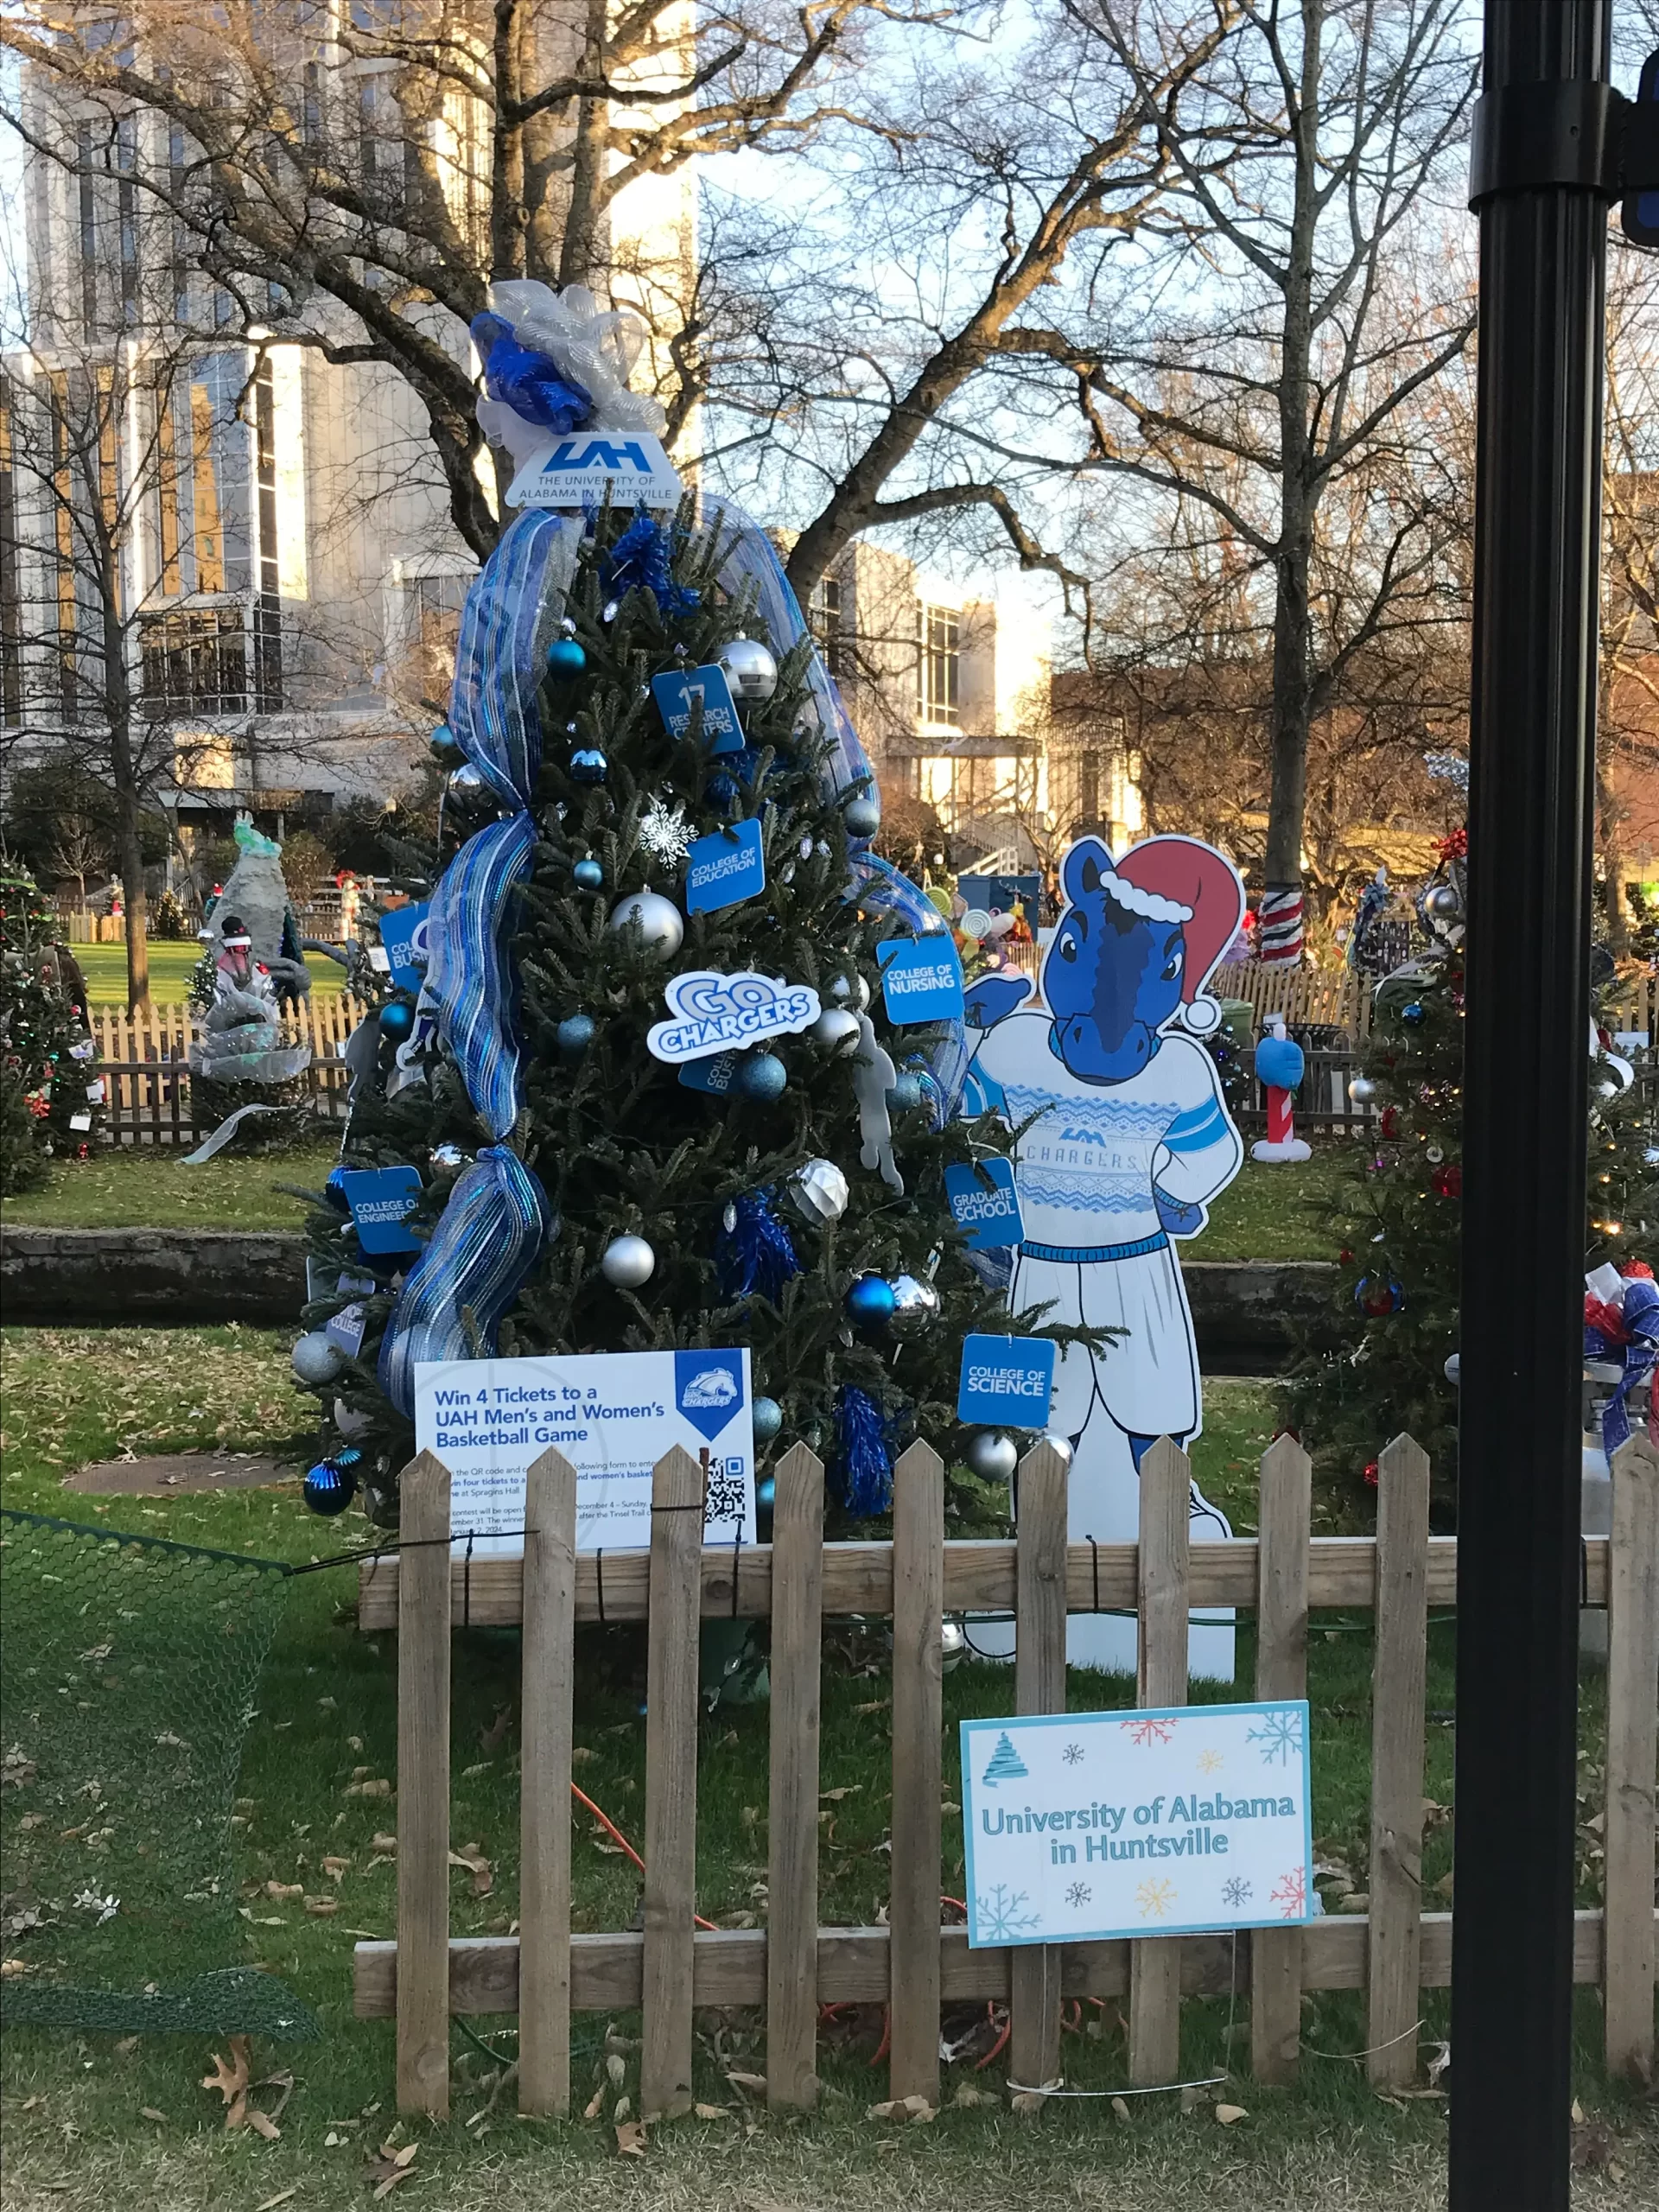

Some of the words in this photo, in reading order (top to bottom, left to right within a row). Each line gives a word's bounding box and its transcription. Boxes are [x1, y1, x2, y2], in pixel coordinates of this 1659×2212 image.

[542, 441, 652, 474] UAH
[538, 476, 561, 486] THE
[639, 476, 656, 486] OF
[520, 489, 577, 499] ALABAMA
[678, 684, 705, 710] 17
[668, 707, 730, 728] RESRCH
[692, 854, 738, 878] COLLEGE
[741, 847, 755, 860] OF
[692, 856, 755, 888] EDUCATION
[887, 966, 935, 981] COLLEGE
[937, 964, 952, 975] OF
[888, 975, 955, 995] NURSING
[677, 979, 776, 1023] GO
[658, 993, 810, 1054] CHARGERS
[1027, 1146, 1136, 1169] CHARGERS
[355, 1200, 404, 1213] COLLEGE
[406, 1199, 419, 1210] O
[953, 1187, 1013, 1207] GRADUATE
[957, 1199, 1016, 1223] SCHOOL
[331, 1315, 361, 1338] COLLEGE
[969, 1366, 1024, 1380] COLLEGE
[1027, 1370, 1046, 1382] OF
[435, 1389, 471, 1406] Win
[476, 1389, 488, 1404] 4
[493, 1387, 556, 1403] Tickets
[562, 1387, 581, 1401] to
[587, 1389, 597, 1399] a
[968, 1376, 1044, 1396] SCIENCE
[435, 1410, 478, 1427] UAH
[485, 1408, 537, 1425] Men's
[543, 1405, 576, 1421] and
[582, 1402, 664, 1421] Women's
[436, 1427, 529, 1447] Basketball
[534, 1427, 588, 1443] Game
[471, 1488, 503, 1498] Spragins
[982, 1802, 1126, 1835] University
[1133, 1796, 1166, 1825] of
[1168, 1793, 1295, 1823] Alabama
[1052, 1839, 1077, 1866] in
[1086, 1827, 1229, 1862] Huntsville
